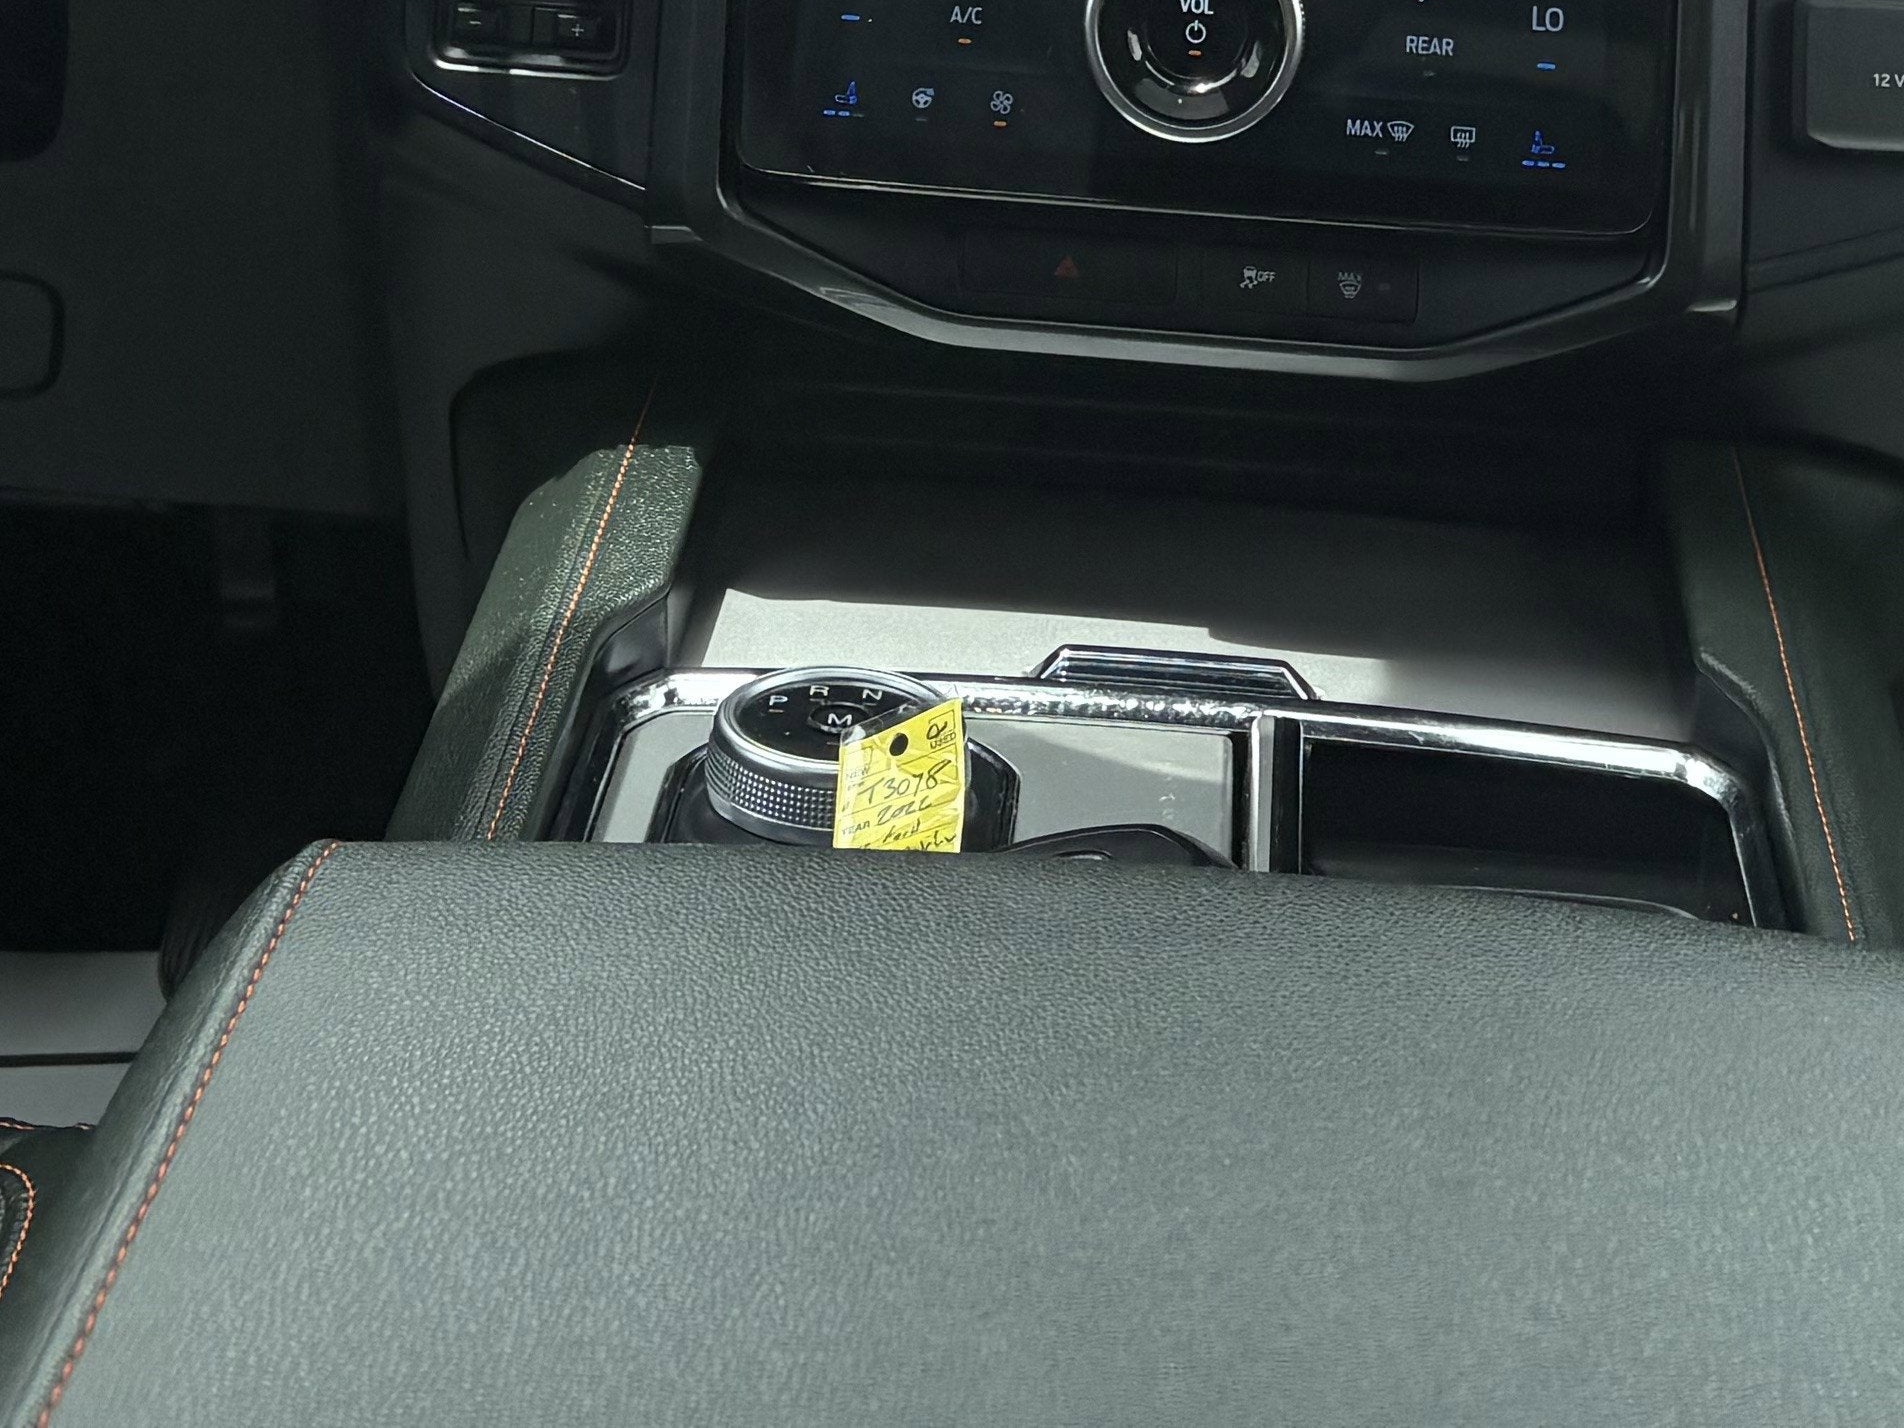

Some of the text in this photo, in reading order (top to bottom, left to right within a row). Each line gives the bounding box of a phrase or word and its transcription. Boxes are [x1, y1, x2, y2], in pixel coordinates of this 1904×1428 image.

[949, 5, 984, 26] A/C
[1530, 5, 1565, 33] LO
[1405, 35, 1455, 57] REAR
[1873, 73, 1891, 88] 12
[1345, 118, 1384, 139] MAX
[768, 694, 790, 707] P
[808, 685, 831, 697] R
[861, 688, 884, 702] N
[827, 712, 854, 727] M
[929, 731, 958, 751] USED
[857, 758, 953, 806] T3078
